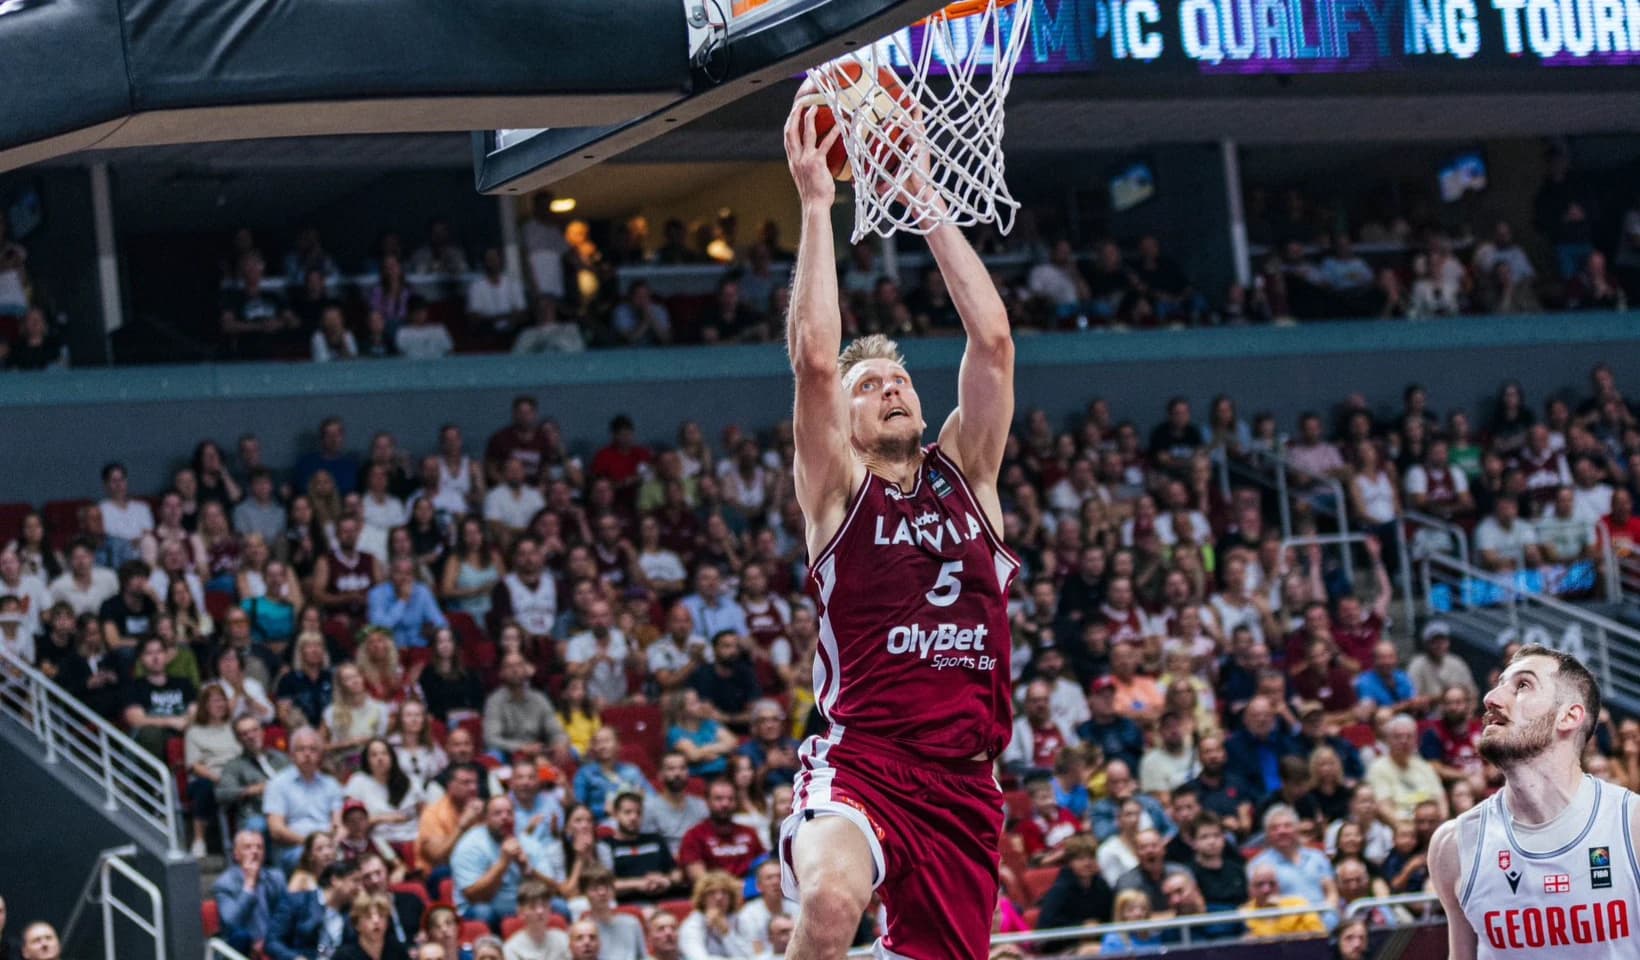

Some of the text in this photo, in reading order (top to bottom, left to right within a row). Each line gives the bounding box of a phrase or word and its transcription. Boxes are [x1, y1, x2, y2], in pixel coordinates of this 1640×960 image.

[1178, 0, 1480, 65] QUALIFYING
[925, 560, 964, 607] 5
[887, 623, 988, 659] OlyBet
[930, 654, 997, 671] Sports Ba
[1484, 899, 1630, 950] GEORGIA
